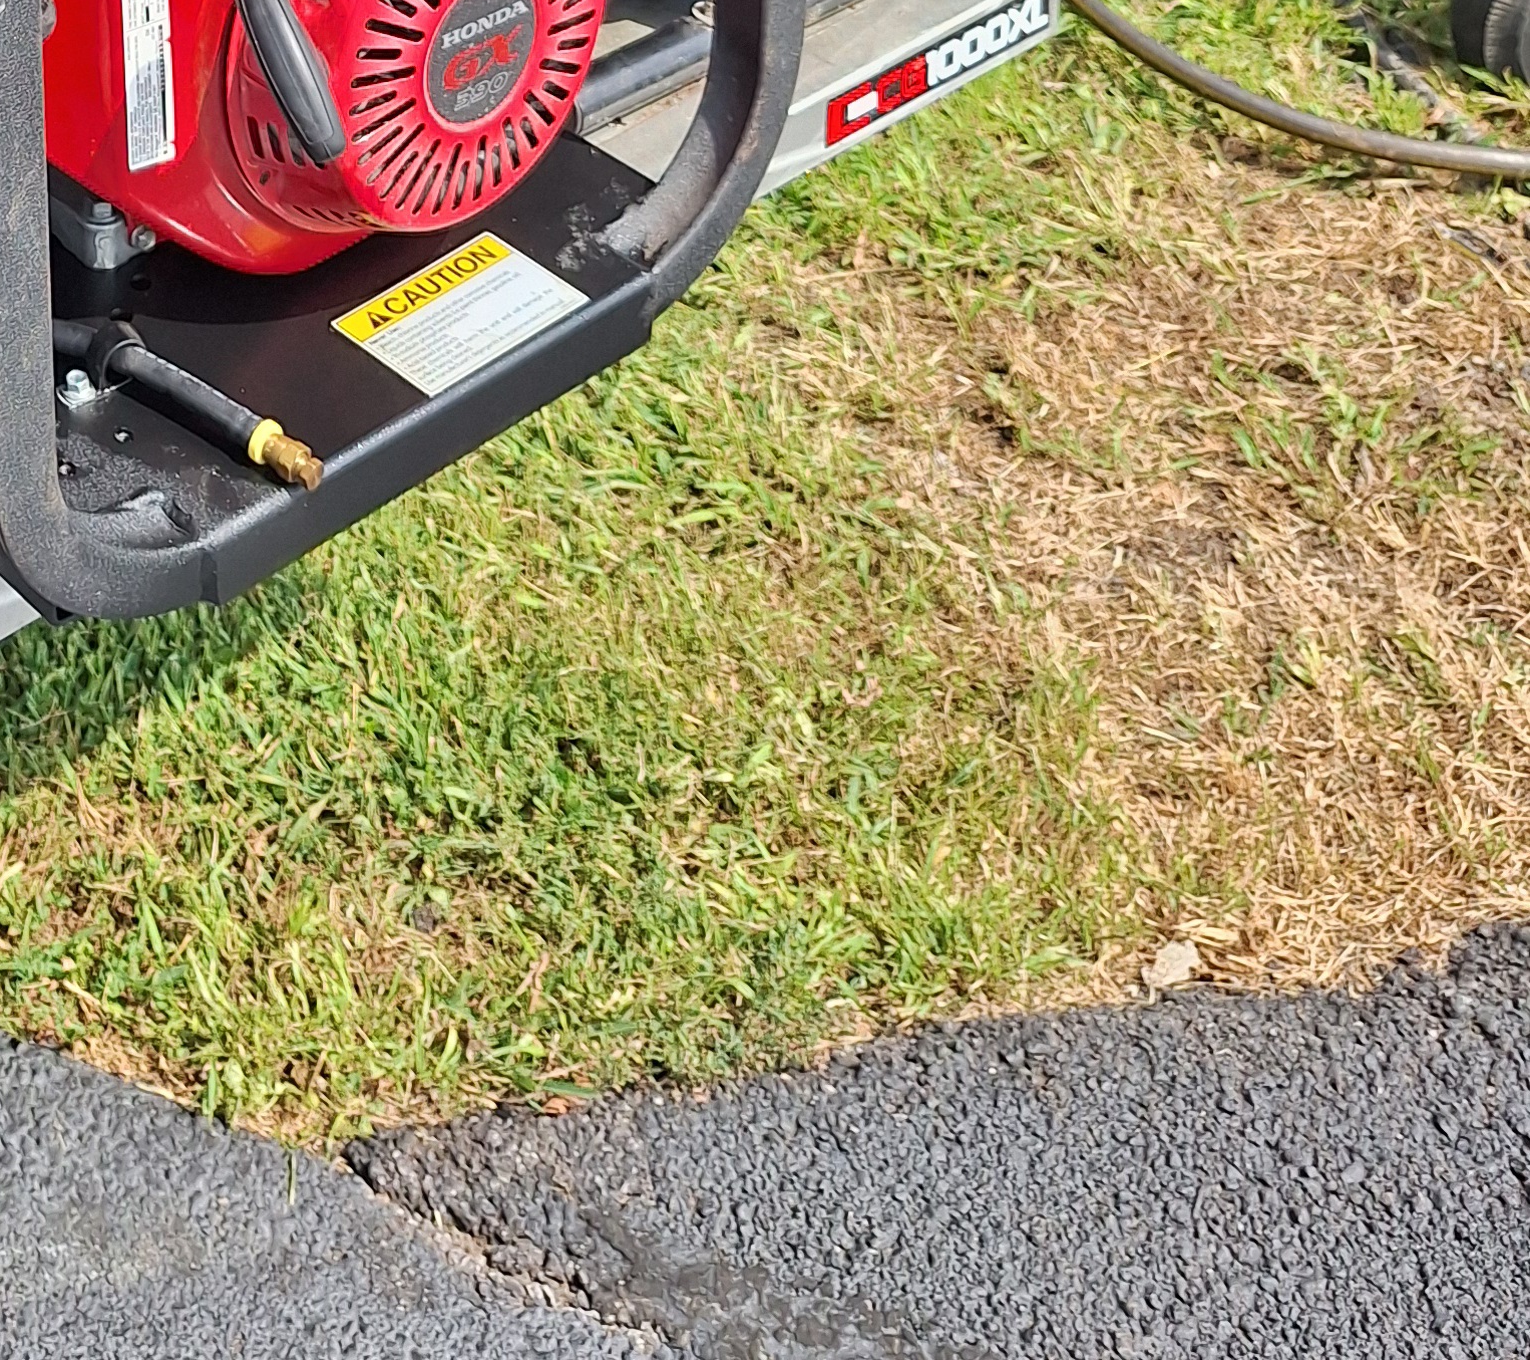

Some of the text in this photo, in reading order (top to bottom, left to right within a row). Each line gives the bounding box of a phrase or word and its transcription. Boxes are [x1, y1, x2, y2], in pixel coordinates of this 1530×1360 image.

[440, 0, 530, 50] HONDA
[443, 23, 524, 92] GX
[382, 243, 498, 316] CAUTION
